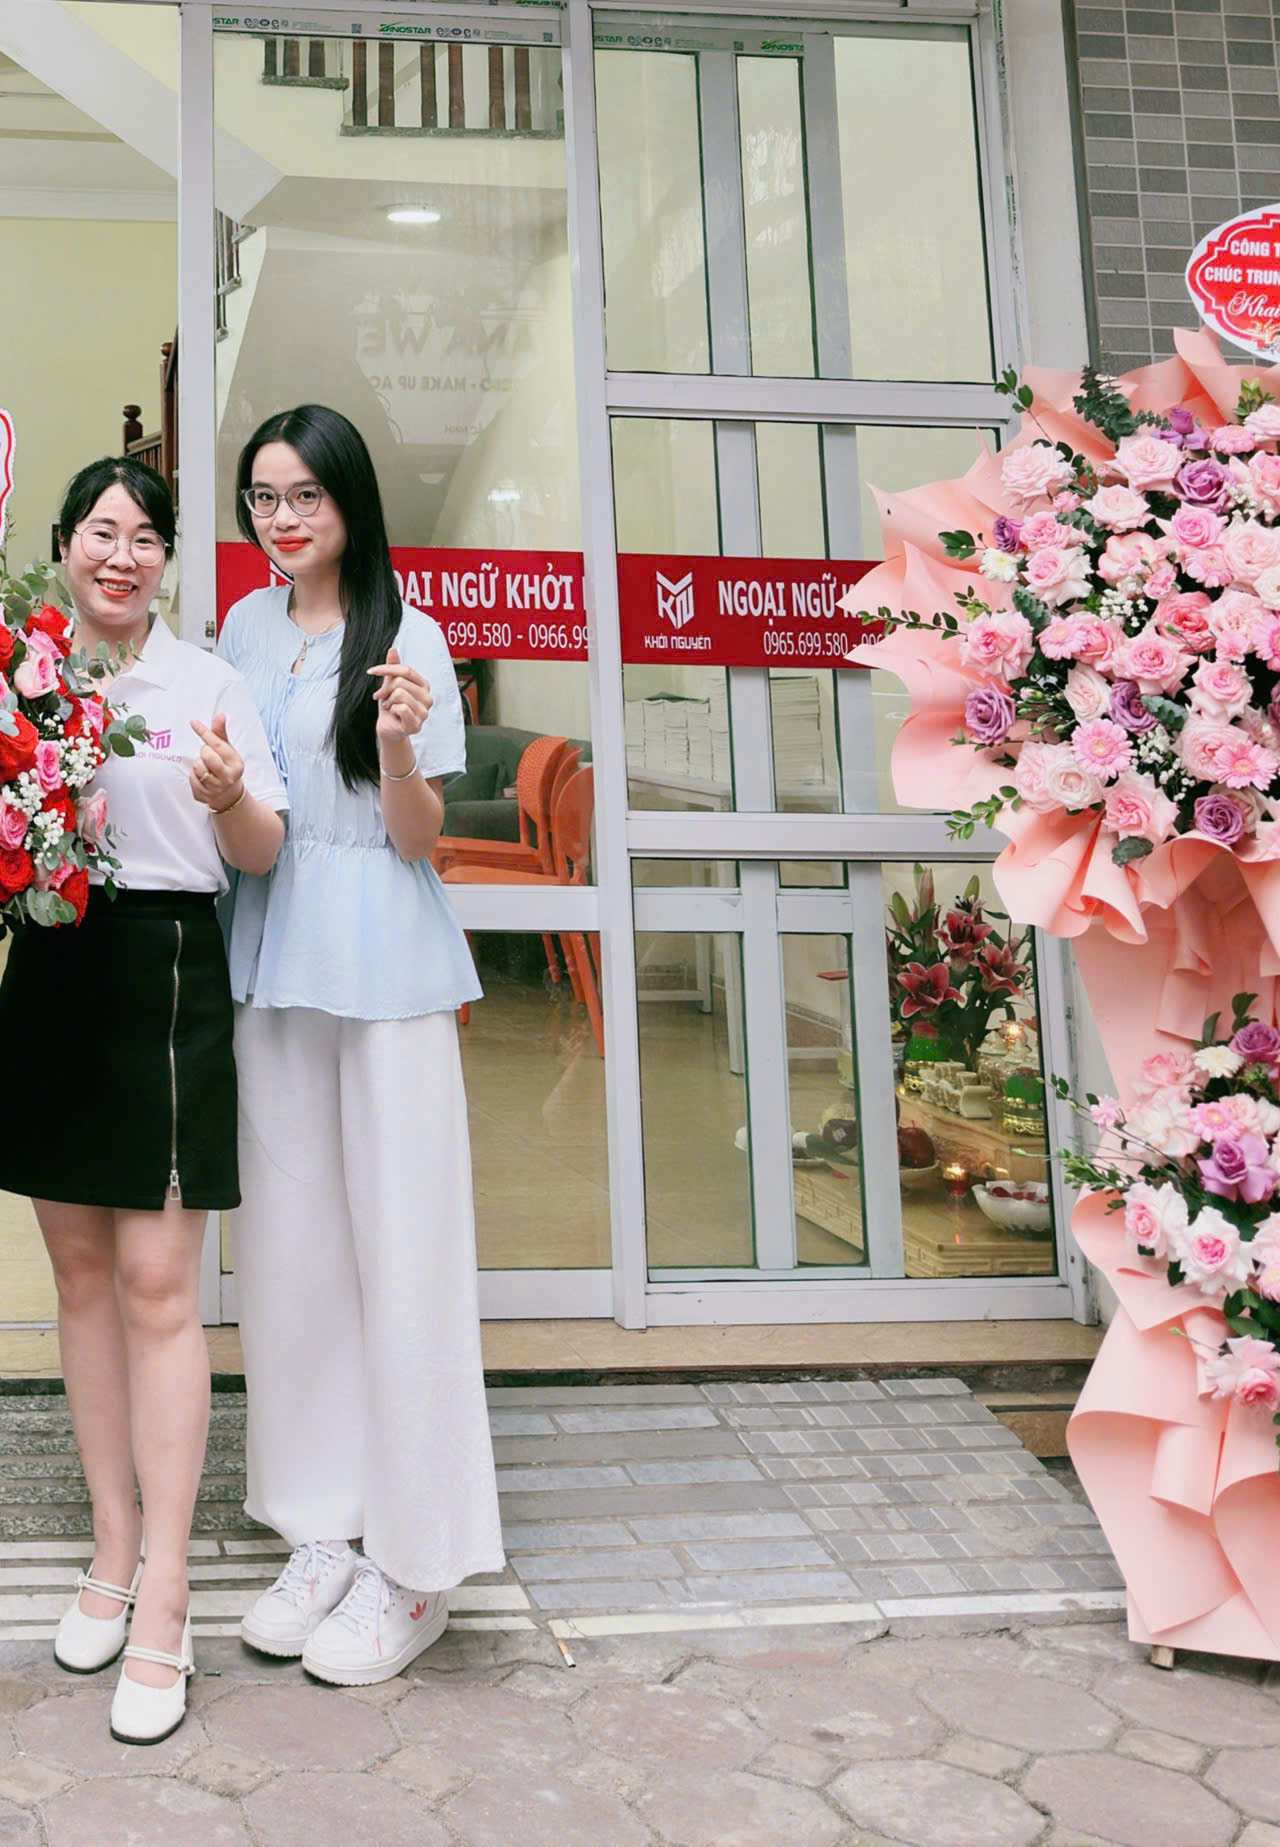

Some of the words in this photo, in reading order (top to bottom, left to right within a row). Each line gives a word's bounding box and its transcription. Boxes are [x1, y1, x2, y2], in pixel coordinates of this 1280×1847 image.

[1230, 238, 1270, 257] CÔNG
[1273, 243, 1280, 257] T
[1204, 265, 1242, 282] CHÚC
[1246, 269, 1280, 285] TRUN
[441, 563, 499, 608] NGỮ
[506, 562, 574, 610] KHỞI
[718, 580, 786, 626] NGOẠI
[792, 572, 837, 618] NGỮ
[763, 631, 848, 656] 0965.699.580
